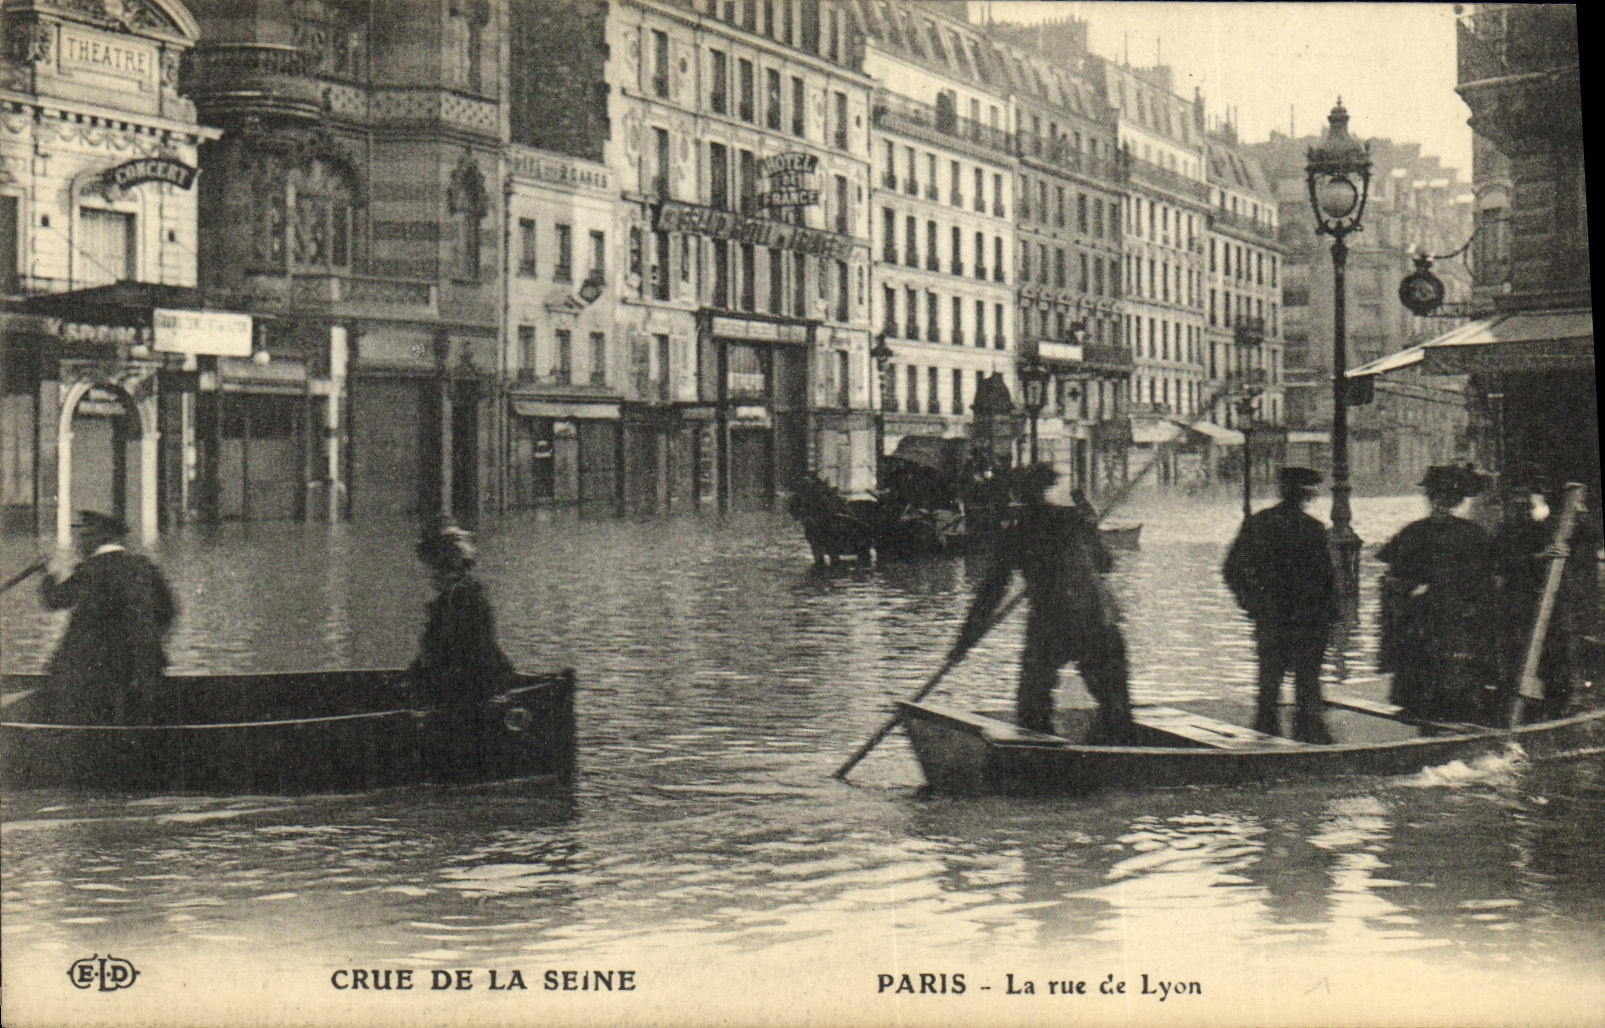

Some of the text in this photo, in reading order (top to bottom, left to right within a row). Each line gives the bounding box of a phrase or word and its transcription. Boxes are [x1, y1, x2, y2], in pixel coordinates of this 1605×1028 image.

[67, 37, 146, 74] THEATRE
[115, 161, 188, 185] CONCERT
[765, 153, 813, 175] HOTEL
[762, 189, 818, 206] FRANCE
